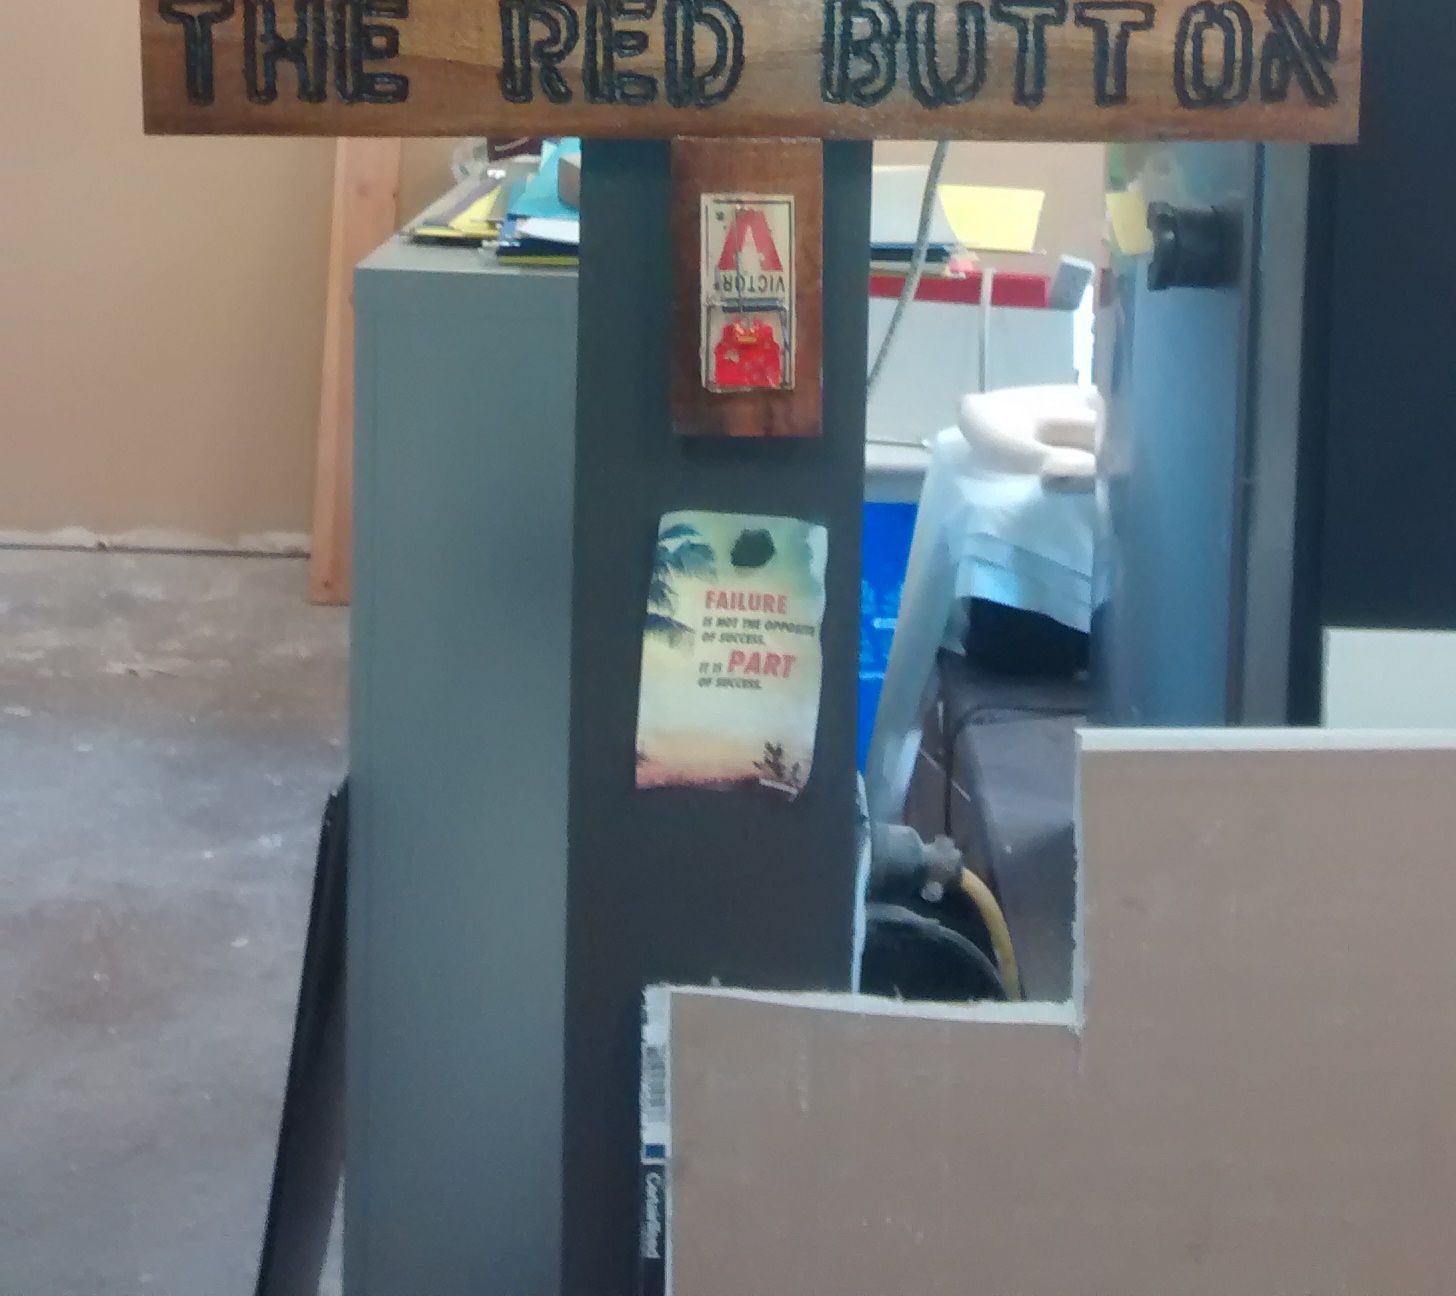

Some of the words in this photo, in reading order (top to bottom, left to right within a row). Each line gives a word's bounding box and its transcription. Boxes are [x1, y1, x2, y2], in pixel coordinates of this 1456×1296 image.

[722, 274, 785, 293] VICTOR
[705, 590, 788, 614] FAILURE
[703, 617, 712, 628] IS
[716, 617, 738, 629] NOT
[742, 618, 760, 630] THE
[701, 632, 715, 642] OF
[726, 649, 796, 678] PART
[698, 677, 712, 688] OF
